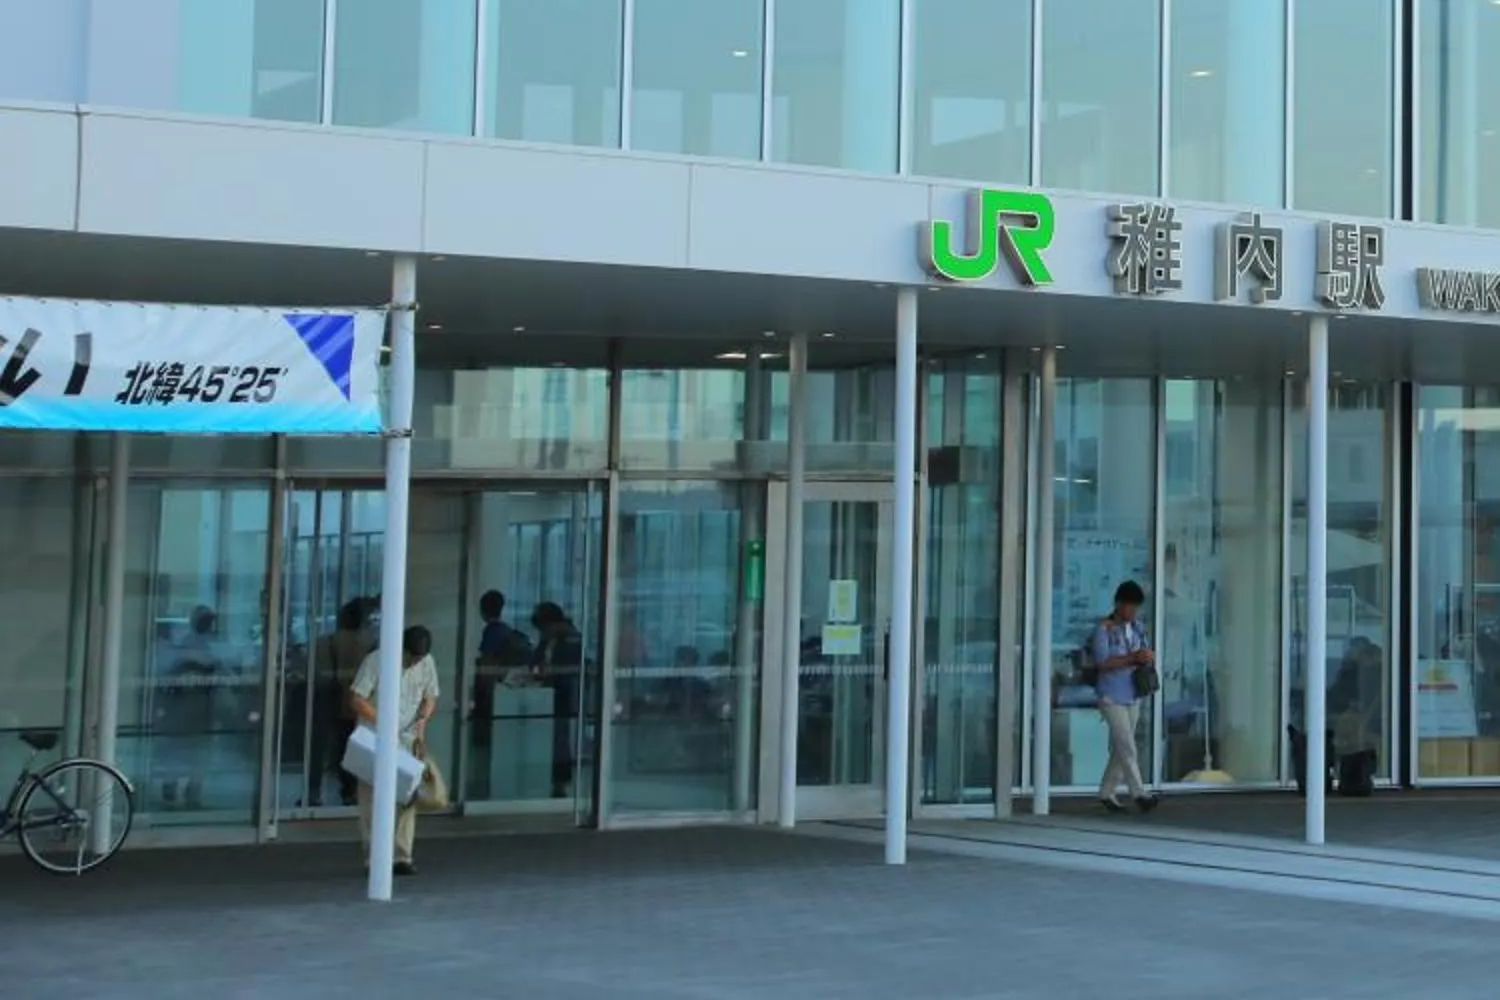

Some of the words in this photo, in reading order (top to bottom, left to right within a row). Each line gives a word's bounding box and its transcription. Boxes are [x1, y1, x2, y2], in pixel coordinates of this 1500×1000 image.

[922, 187, 1056, 286] JR
[1109, 200, 1386, 311] 稚内駅
